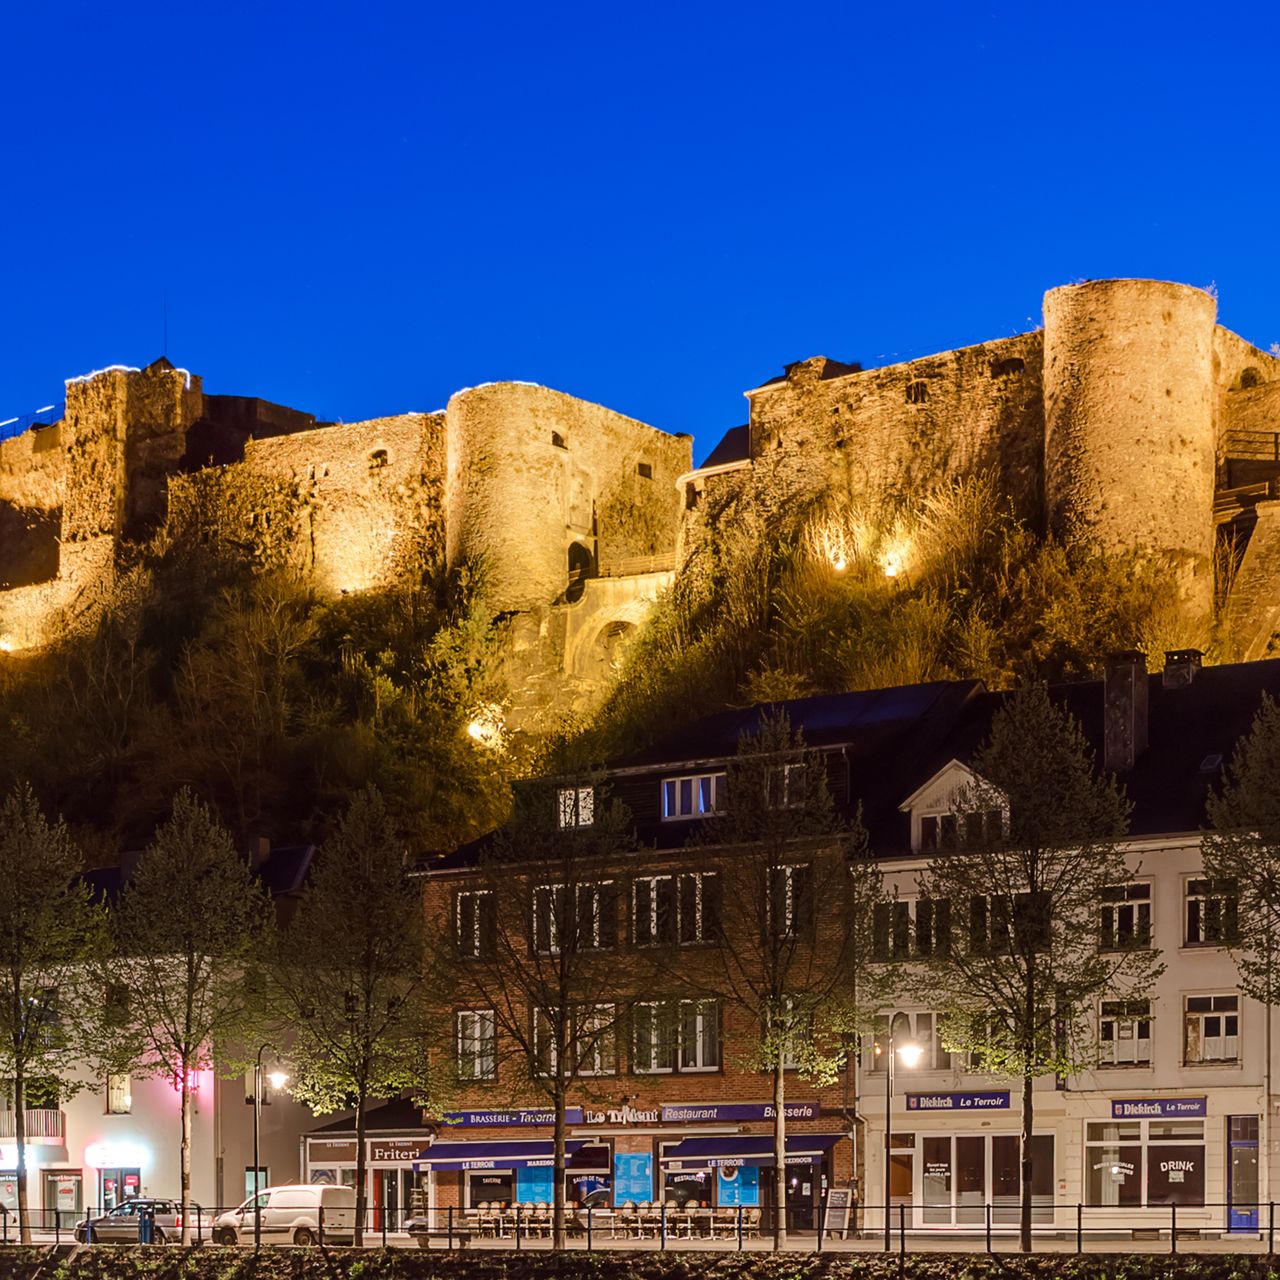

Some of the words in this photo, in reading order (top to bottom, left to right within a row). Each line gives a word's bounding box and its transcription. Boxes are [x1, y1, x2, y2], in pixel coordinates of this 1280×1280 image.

[920, 1096, 953, 1108] Diekirch
[960, 1098, 972, 1107] Le
[973, 1097, 1004, 1107] Terroir
[665, 1108, 718, 1119] Restaurant
[763, 1105, 813, 1118] Brsserie
[1123, 1102, 1162, 1115] Diekirch
[1166, 1103, 1176, 1111] Le
[1177, 1103, 1200, 1111] Terroir
[374, 1148, 420, 1160] Friteri
[462, 1162, 470, 1170] LE
[471, 1161, 495, 1169] TERROIR
[707, 1160, 716, 1168] LE
[717, 1158, 745, 1167] TERROIR
[1160, 1160, 1195, 1172] DRINK
